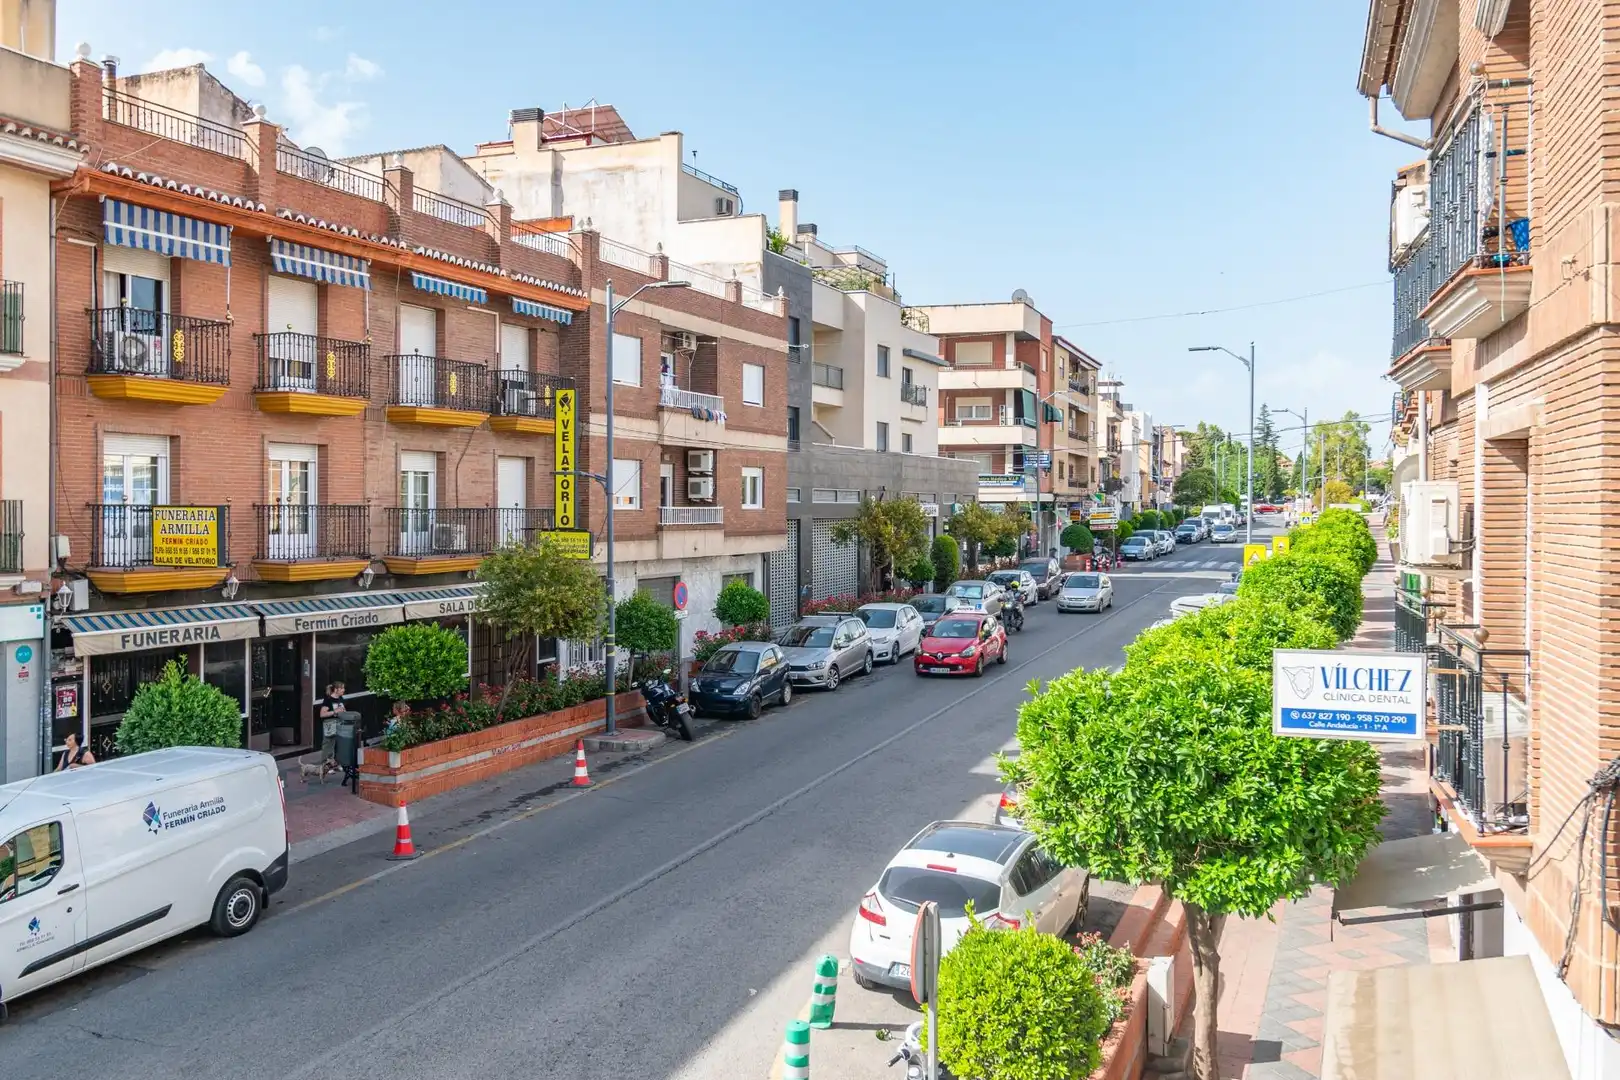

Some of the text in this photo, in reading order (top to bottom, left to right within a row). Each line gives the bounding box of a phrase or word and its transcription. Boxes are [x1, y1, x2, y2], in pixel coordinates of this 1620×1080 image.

[560, 419, 570, 526] VELATORIO
[155, 510, 216, 521] FUNERARIA
[160, 523, 210, 535] ARMILLA
[185, 538, 209, 546] CRIADO
[184, 557, 216, 565] VELATORIO
[439, 601, 465, 614] SALA
[295, 612, 379, 631] Fermín Criado
[121, 626, 221, 649] FUNERARIA
[1320, 663, 1412, 692] VÍLCHEZ
[1323, 692, 1411, 704] CLÍNICA DENTAL
[1301, 712, 1316, 720] 637
[1318, 712, 1332, 720] 827
[1335, 713, 1350, 721] 190
[1357, 714, 1372, 722] 958
[1374, 715, 1390, 723] 570
[1391, 716, 1407, 724] 290
[1327, 721, 1358, 730] Andalucía
[163, 796, 224, 820] Funeraria Armilla
[164, 804, 226, 830] FERMÍN CRIADO
